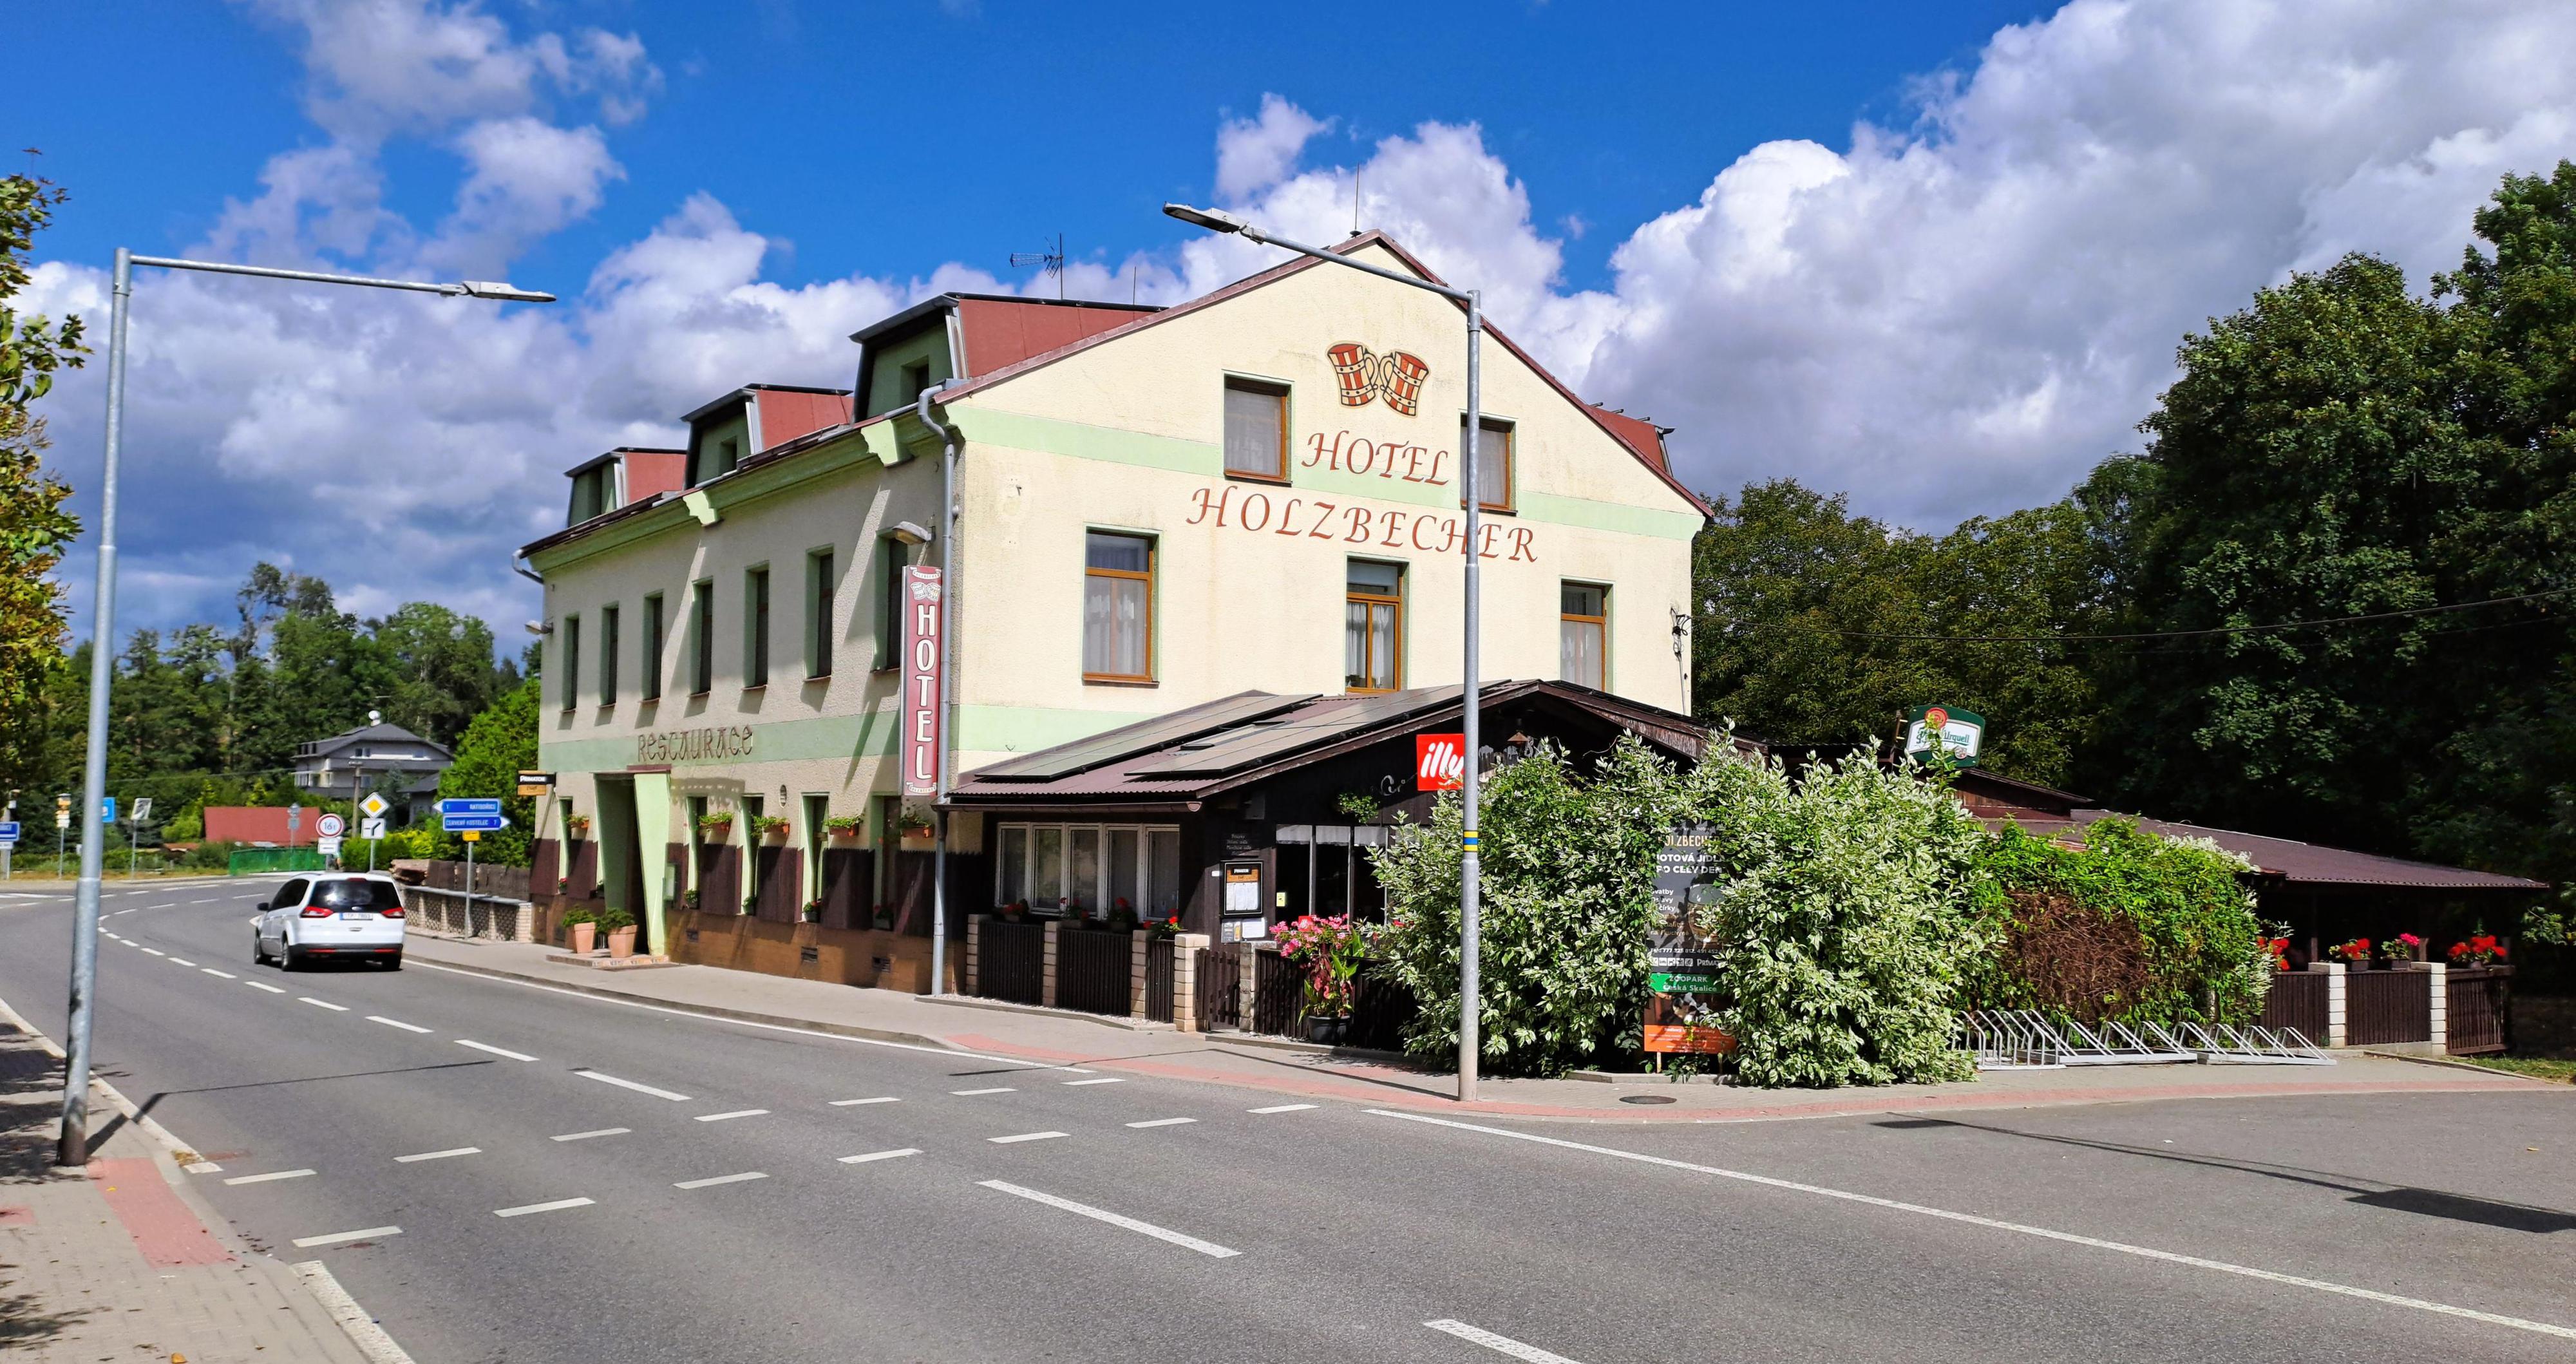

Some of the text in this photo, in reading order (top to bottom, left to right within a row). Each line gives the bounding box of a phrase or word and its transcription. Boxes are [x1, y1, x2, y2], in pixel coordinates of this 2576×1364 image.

[1301, 430, 1449, 486] HOTEL
[1186, 485, 1538, 563] HOLZBECHER
[915, 604, 936, 780] HOTEL
[1420, 741, 1464, 778] illy
